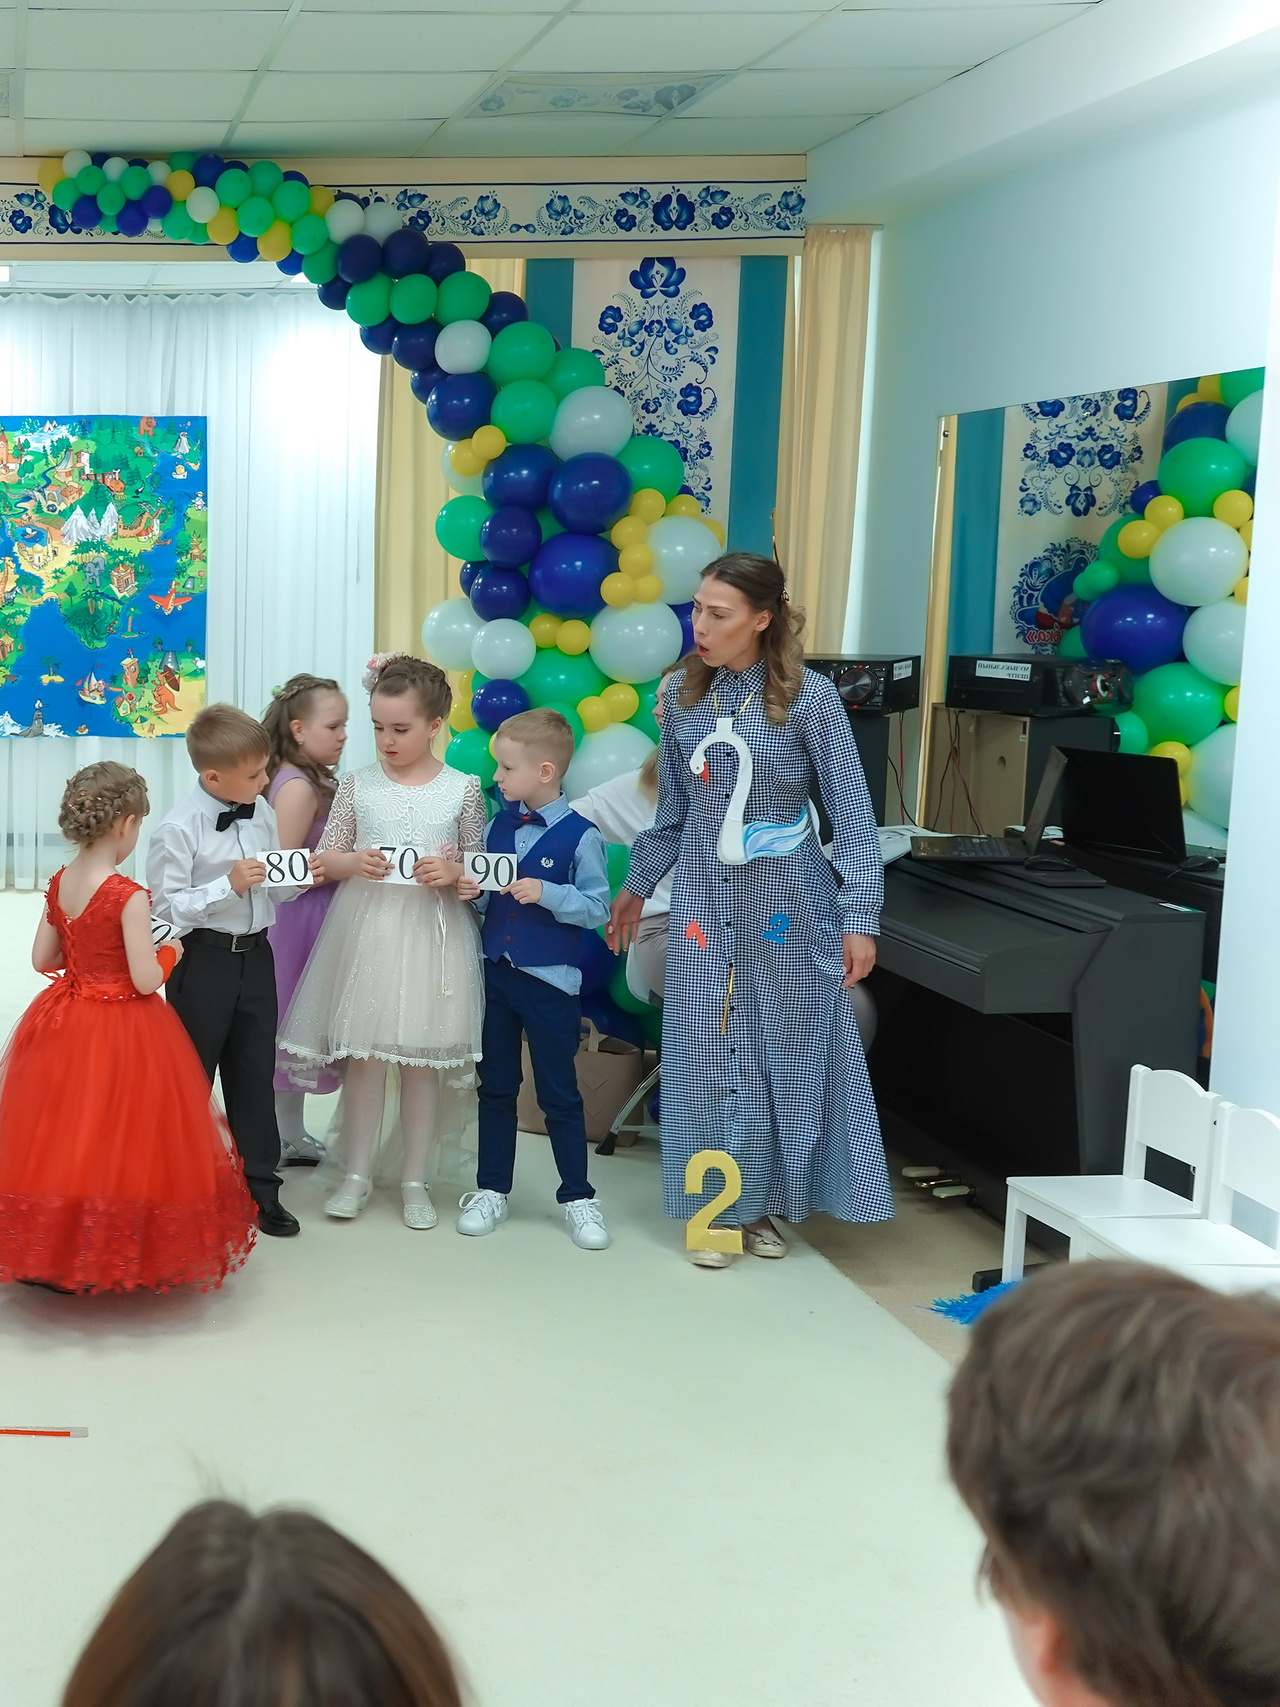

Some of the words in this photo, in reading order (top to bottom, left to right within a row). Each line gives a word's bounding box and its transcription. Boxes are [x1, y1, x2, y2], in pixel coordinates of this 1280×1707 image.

[266, 851, 309, 883] 80
[380, 846, 419, 880] 70
[471, 854, 514, 888] 90
[762, 913, 790, 944] 2
[685, 1150, 745, 1254] 2
